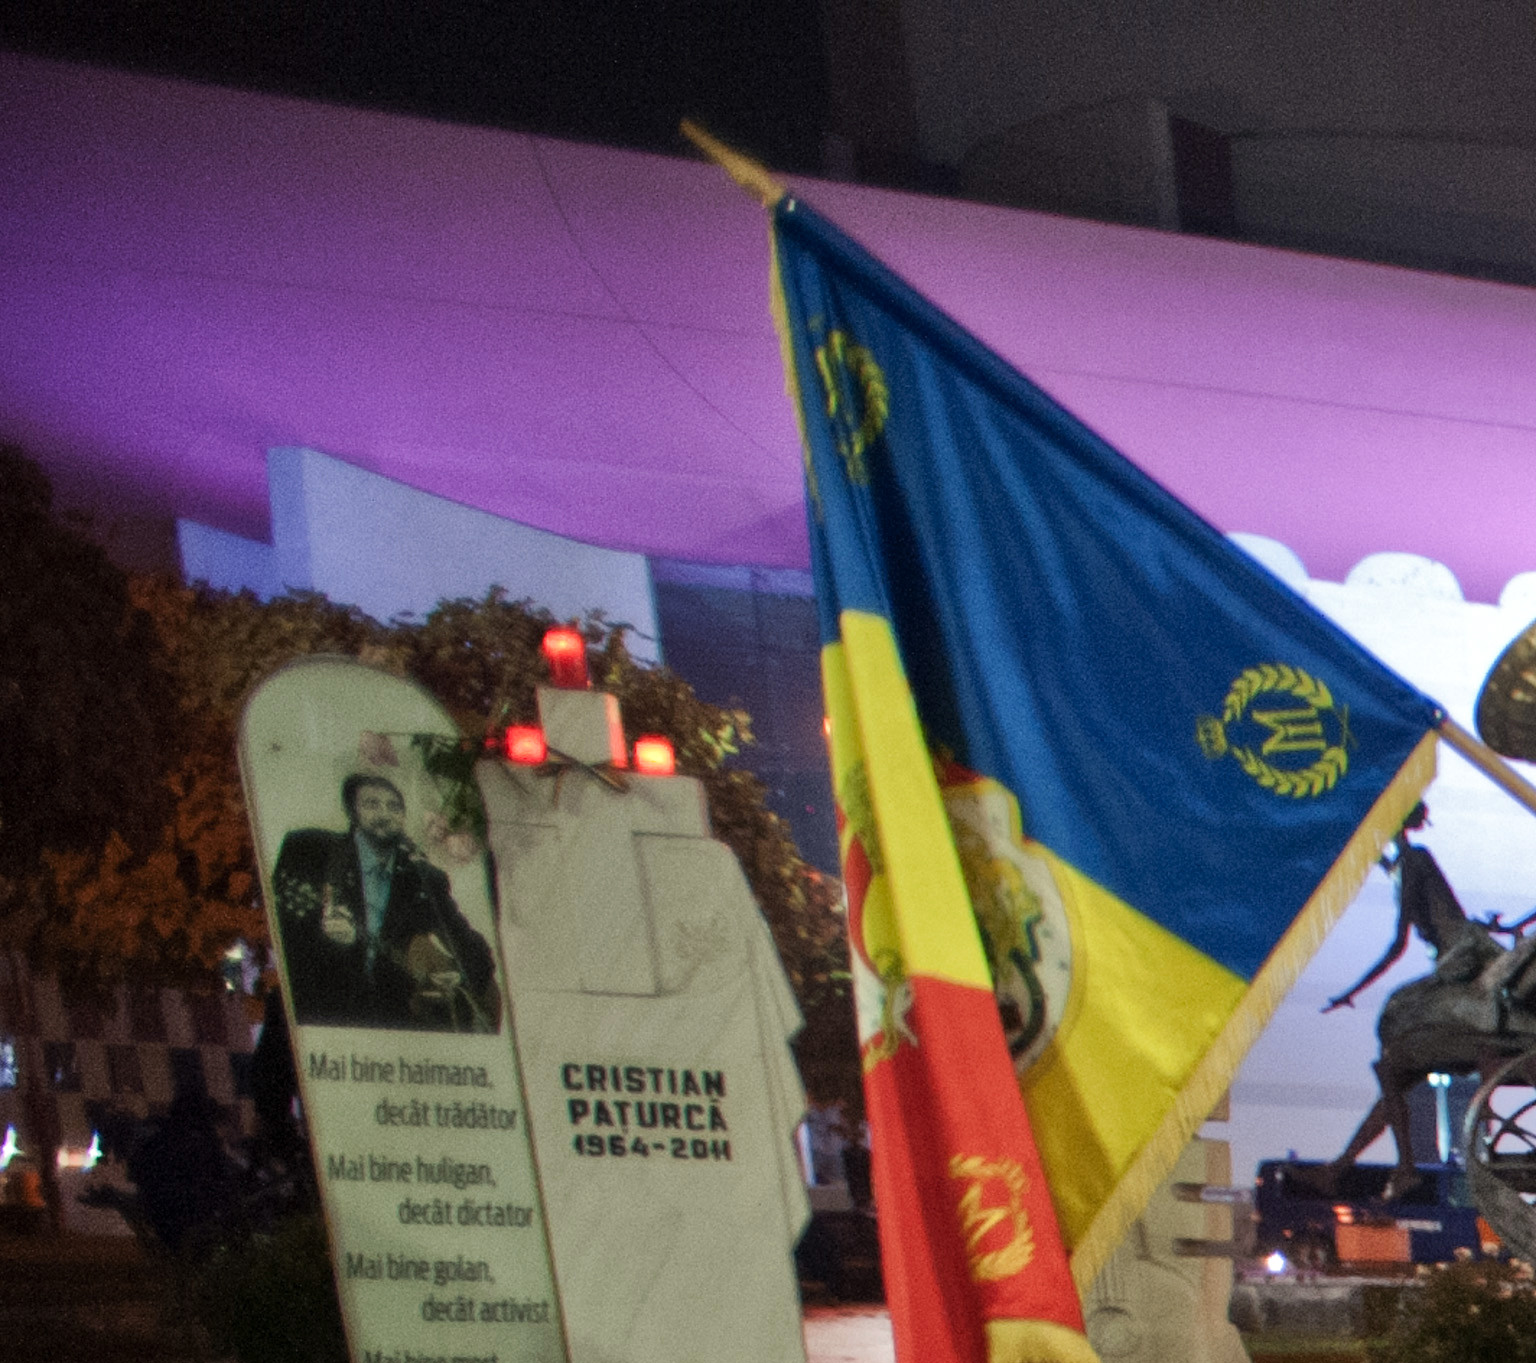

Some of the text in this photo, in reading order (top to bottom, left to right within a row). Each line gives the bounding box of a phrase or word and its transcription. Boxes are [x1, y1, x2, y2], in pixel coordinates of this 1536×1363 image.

[308, 1052, 495, 1088] Mai bine haimana,
[561, 1063, 728, 1098] CRISTIAN
[573, 1133, 733, 1162] 1964-2011
[327, 1155, 496, 1190] Mai bine huligan,
[457, 1202, 533, 1228] dictator
[346, 1252, 496, 1287] Mai bine golan,
[479, 1297, 550, 1324] activist
